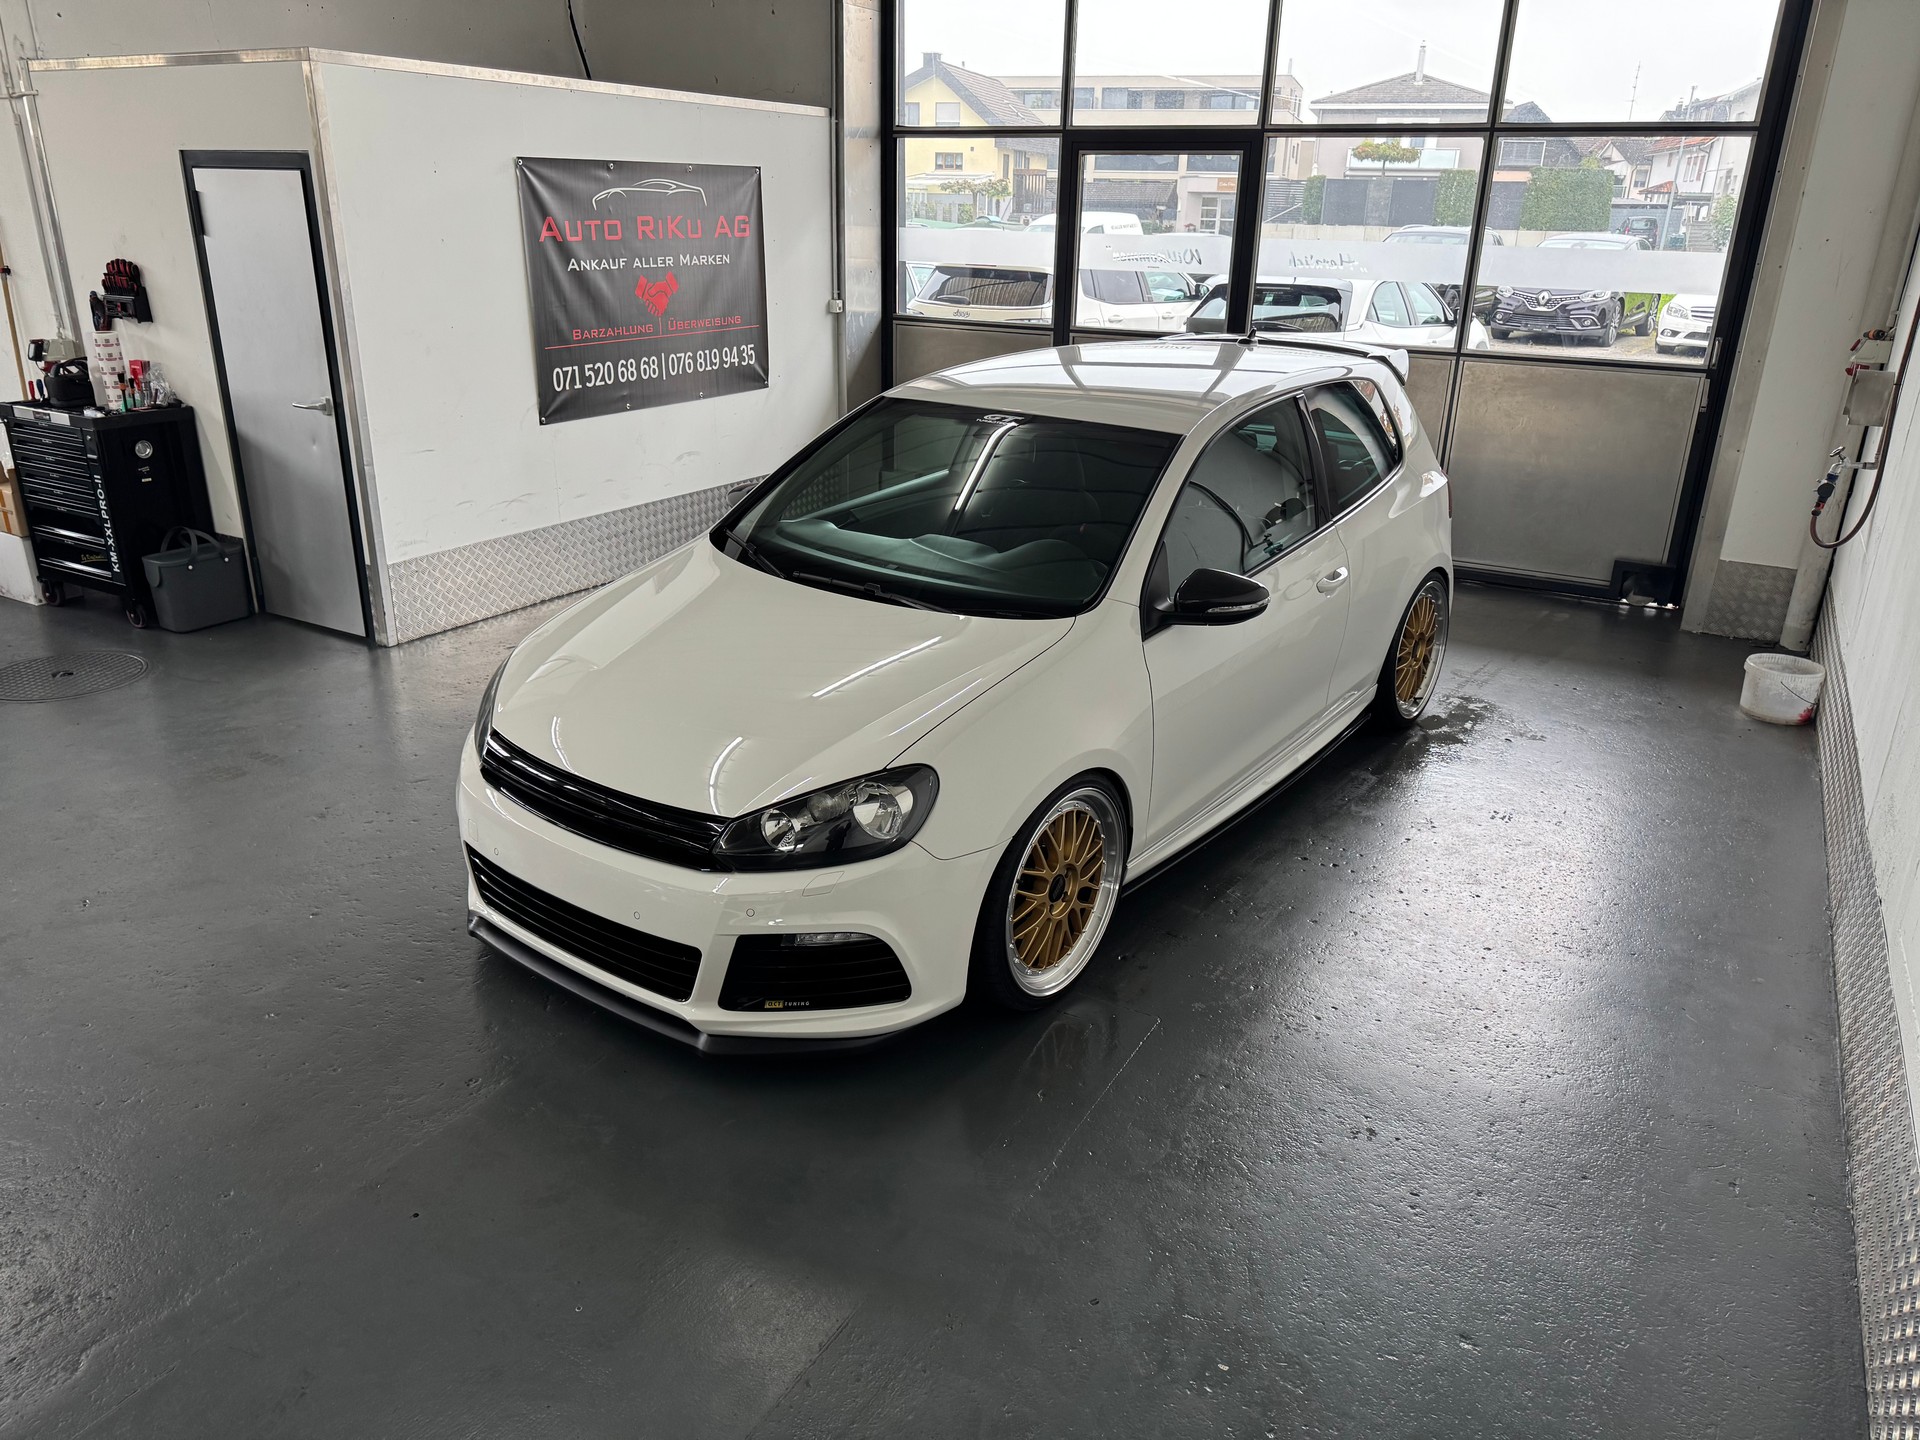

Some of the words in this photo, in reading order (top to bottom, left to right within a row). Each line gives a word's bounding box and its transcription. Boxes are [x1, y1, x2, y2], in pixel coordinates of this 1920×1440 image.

[539, 216, 623, 243] AUTO
[714, 215, 750, 239] AG
[567, 257, 628, 272] ANKAUF
[632, 256, 674, 269] ALLER
[679, 254, 731, 266] MARKEN
[572, 323, 654, 341] BARZAHLUNG
[668, 315, 742, 331] ÜBERWEISUNG
[552, 365, 583, 392] 071
[584, 361, 615, 387] 520
[617, 358, 637, 383] 68
[640, 355, 659, 381] 68
[668, 351, 694, 377] 076
[696, 348, 721, 372] 819
[722, 346, 739, 369] 94
[740, 343, 756, 366] 35
